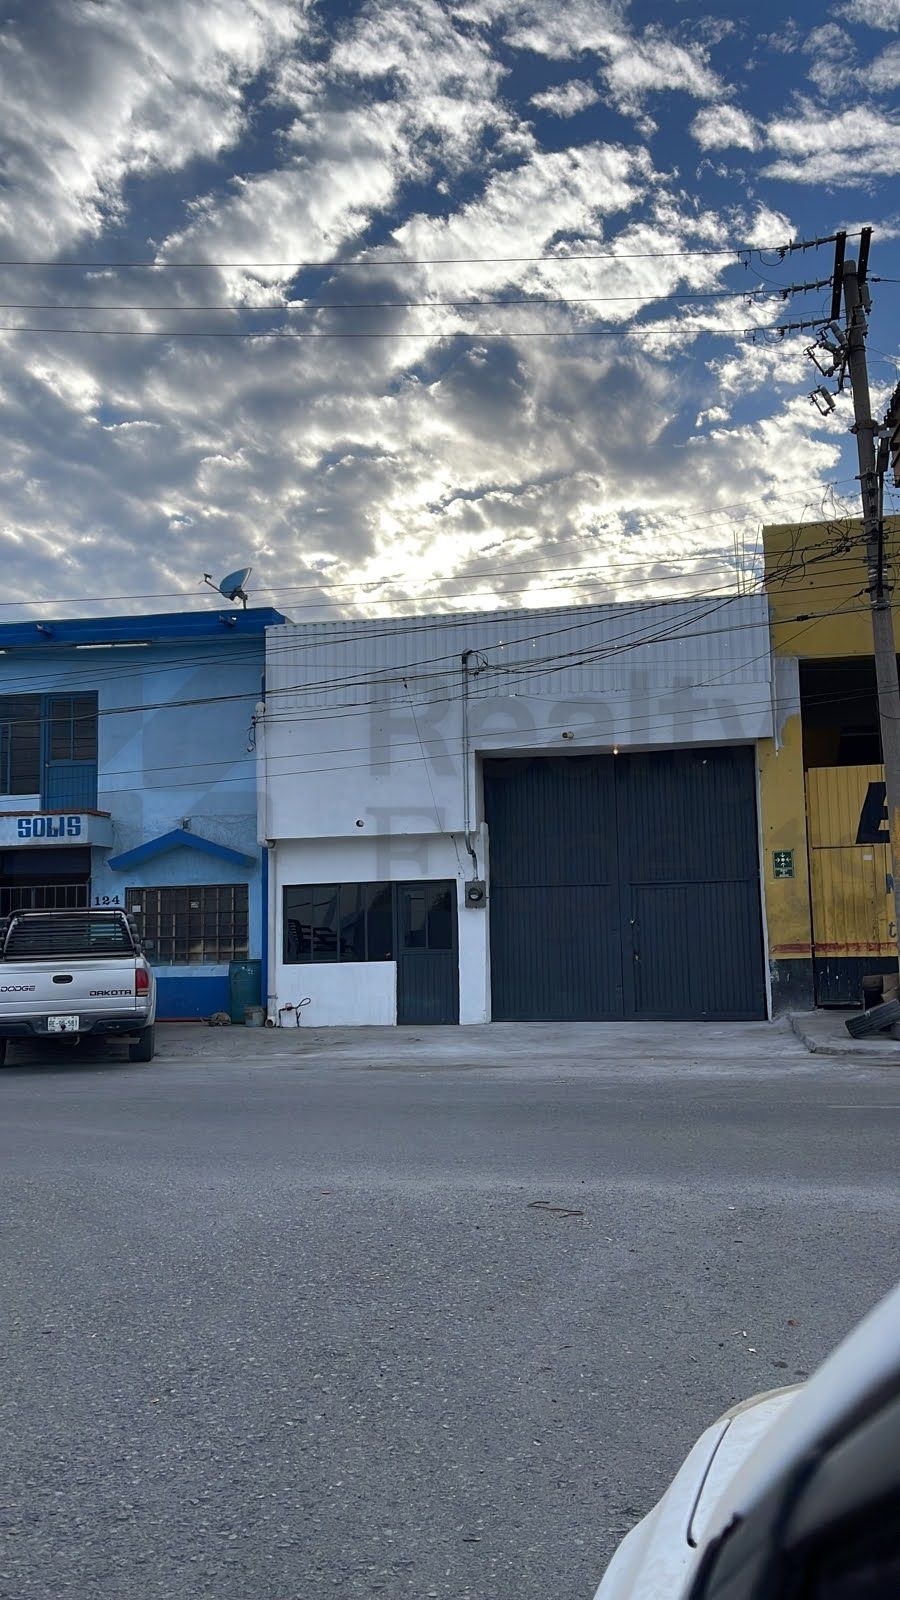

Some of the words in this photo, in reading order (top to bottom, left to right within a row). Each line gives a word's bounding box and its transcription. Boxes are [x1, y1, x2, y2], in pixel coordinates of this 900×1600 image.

[17, 816, 81, 837] SOLIS
[94, 895, 120, 906] 124
[89, 989, 132, 997] DAKOTA
